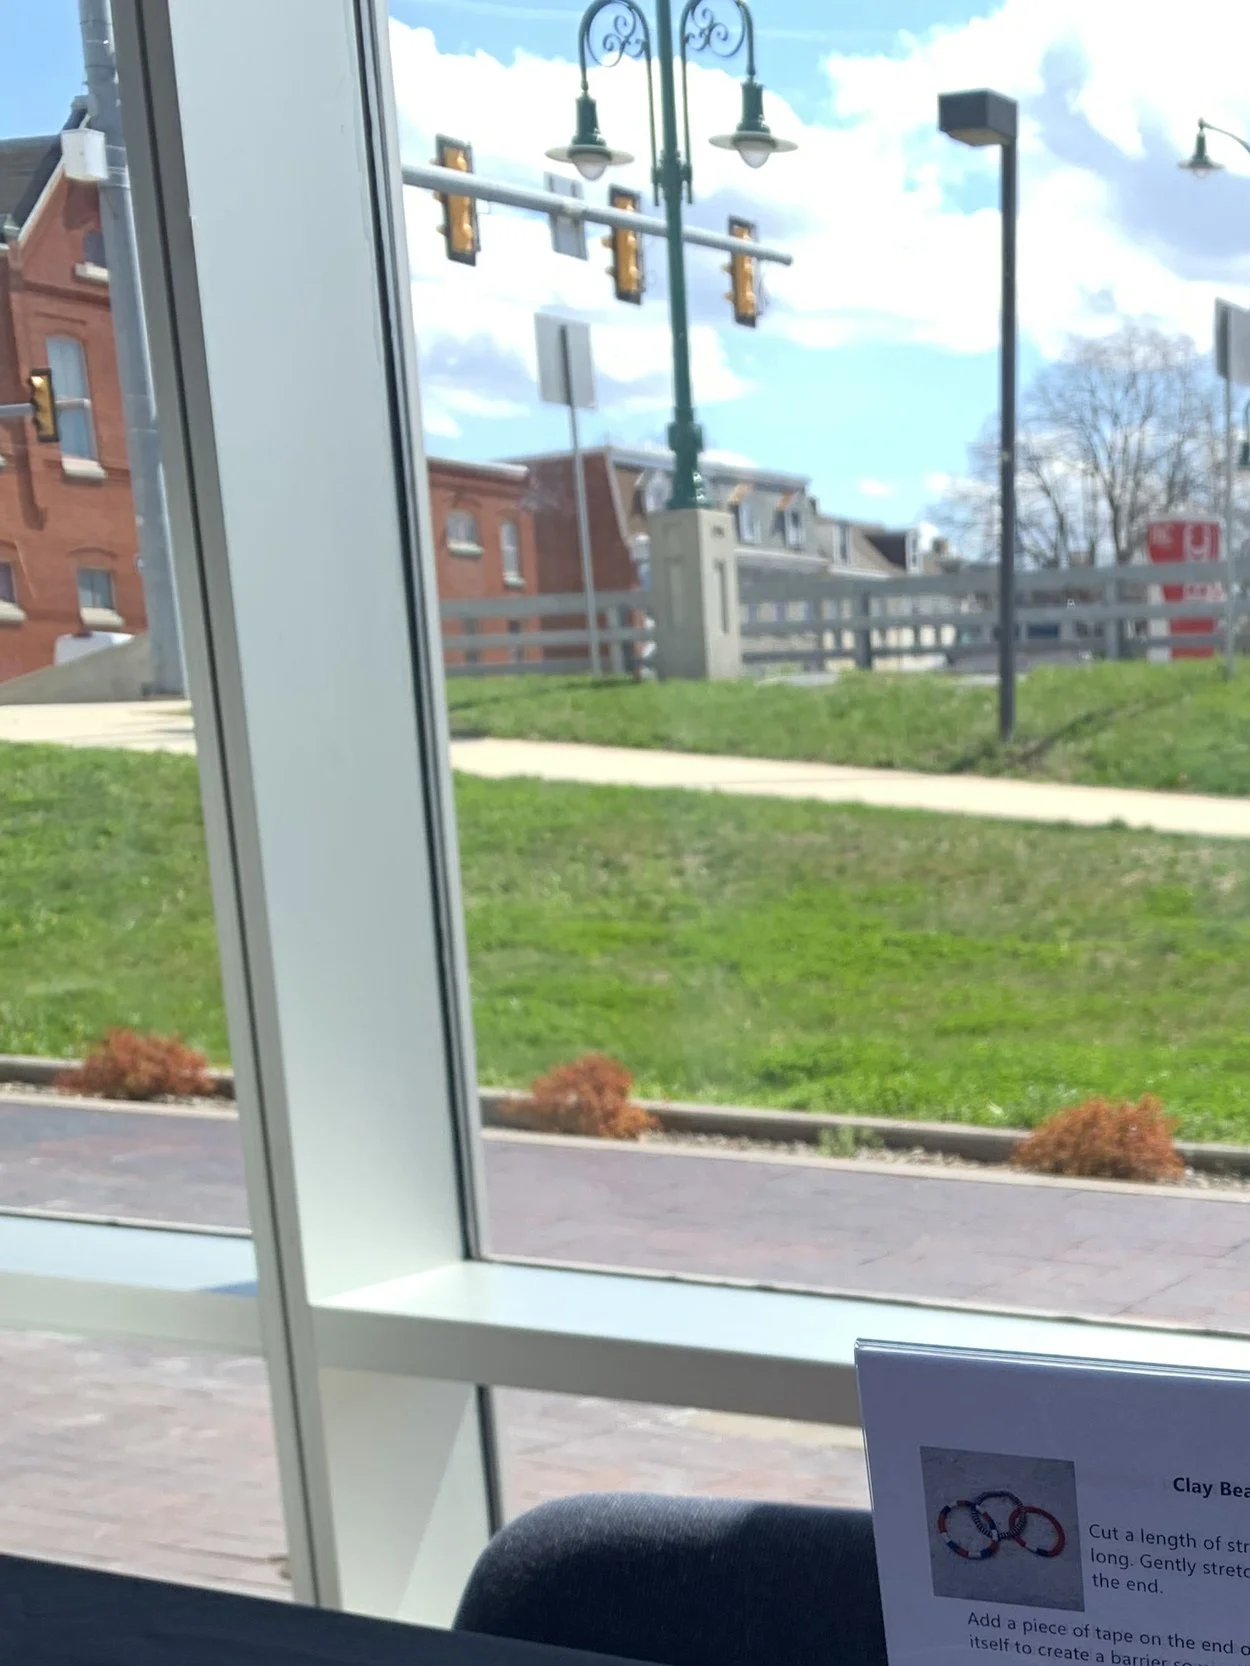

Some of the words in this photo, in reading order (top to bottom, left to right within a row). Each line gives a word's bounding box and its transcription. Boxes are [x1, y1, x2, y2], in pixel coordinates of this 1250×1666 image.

[1173, 1477, 1212, 1498] Clay
[1089, 1524, 1118, 1540] Cut
[1125, 1530, 1134, 1542] a
[1141, 1528, 1196, 1550] length
[1204, 1536, 1222, 1551] of
[1091, 1548, 1133, 1569] long.
[1140, 1554, 1196, 1576] Gently
[1093, 1573, 1120, 1589] the
[1127, 1578, 1163, 1594] end.
[968, 1612, 1000, 1628] Add
[1007, 1619, 1016, 1630] a
[1023, 1619, 1066, 1635] piece
[1073, 1624, 1091, 1638] of
[1096, 1627, 1133, 1645] tape
[1140, 1634, 1161, 1646] on
[1168, 1634, 1194, 1650] the
[1202, 1639, 1233, 1654] end
[970, 1634, 1010, 1652] itself
[1015, 1640, 1032, 1655] to
[1038, 1644, 1089, 1661] create
[1096, 1652, 1104, 1663] a
